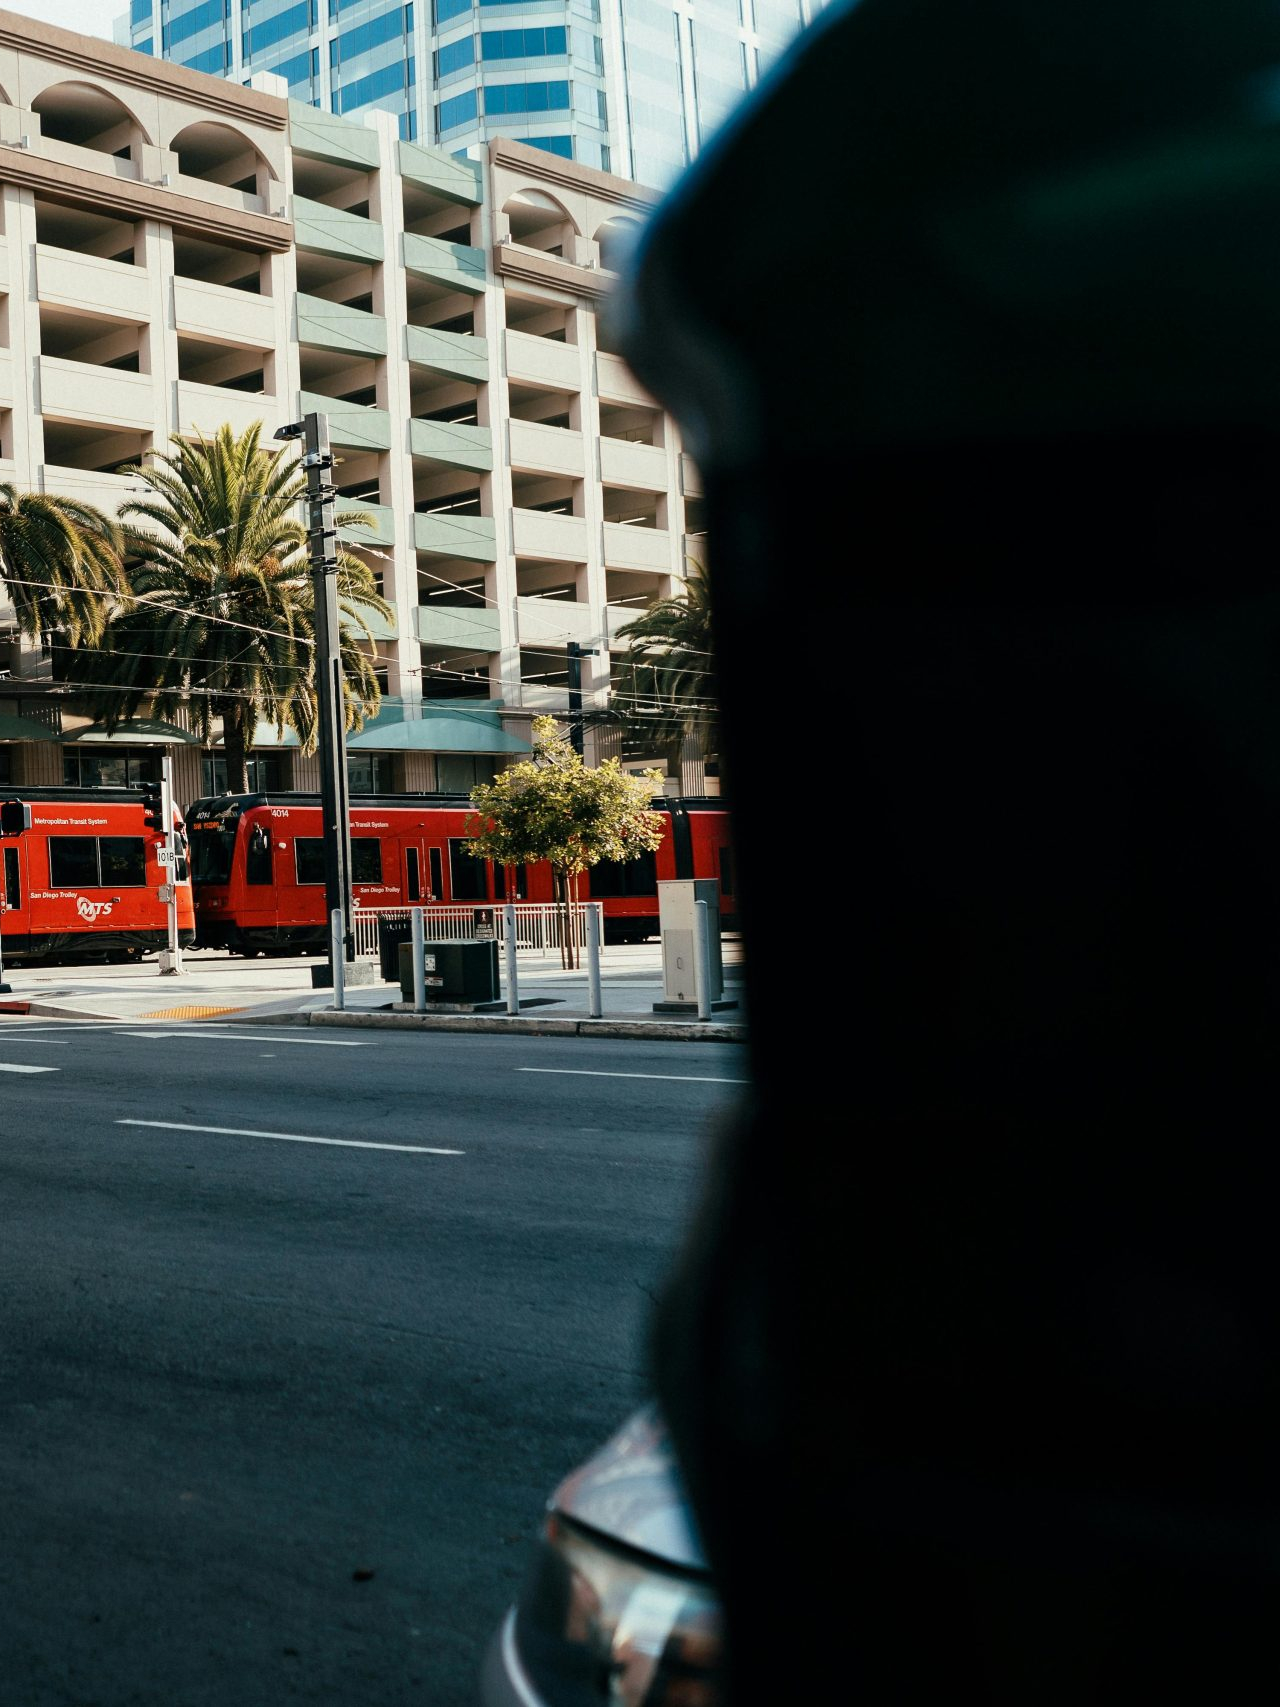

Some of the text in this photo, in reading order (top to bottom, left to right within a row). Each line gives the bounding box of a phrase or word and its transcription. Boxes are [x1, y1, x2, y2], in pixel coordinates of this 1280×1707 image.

[271, 809, 289, 818] 4014
[34, 817, 68, 826] Metropolitan
[87, 818, 108, 826] System
[158, 852, 175, 862] 101B
[59, 891, 78, 899] Trolley
[78, 902, 112, 915] MTS
